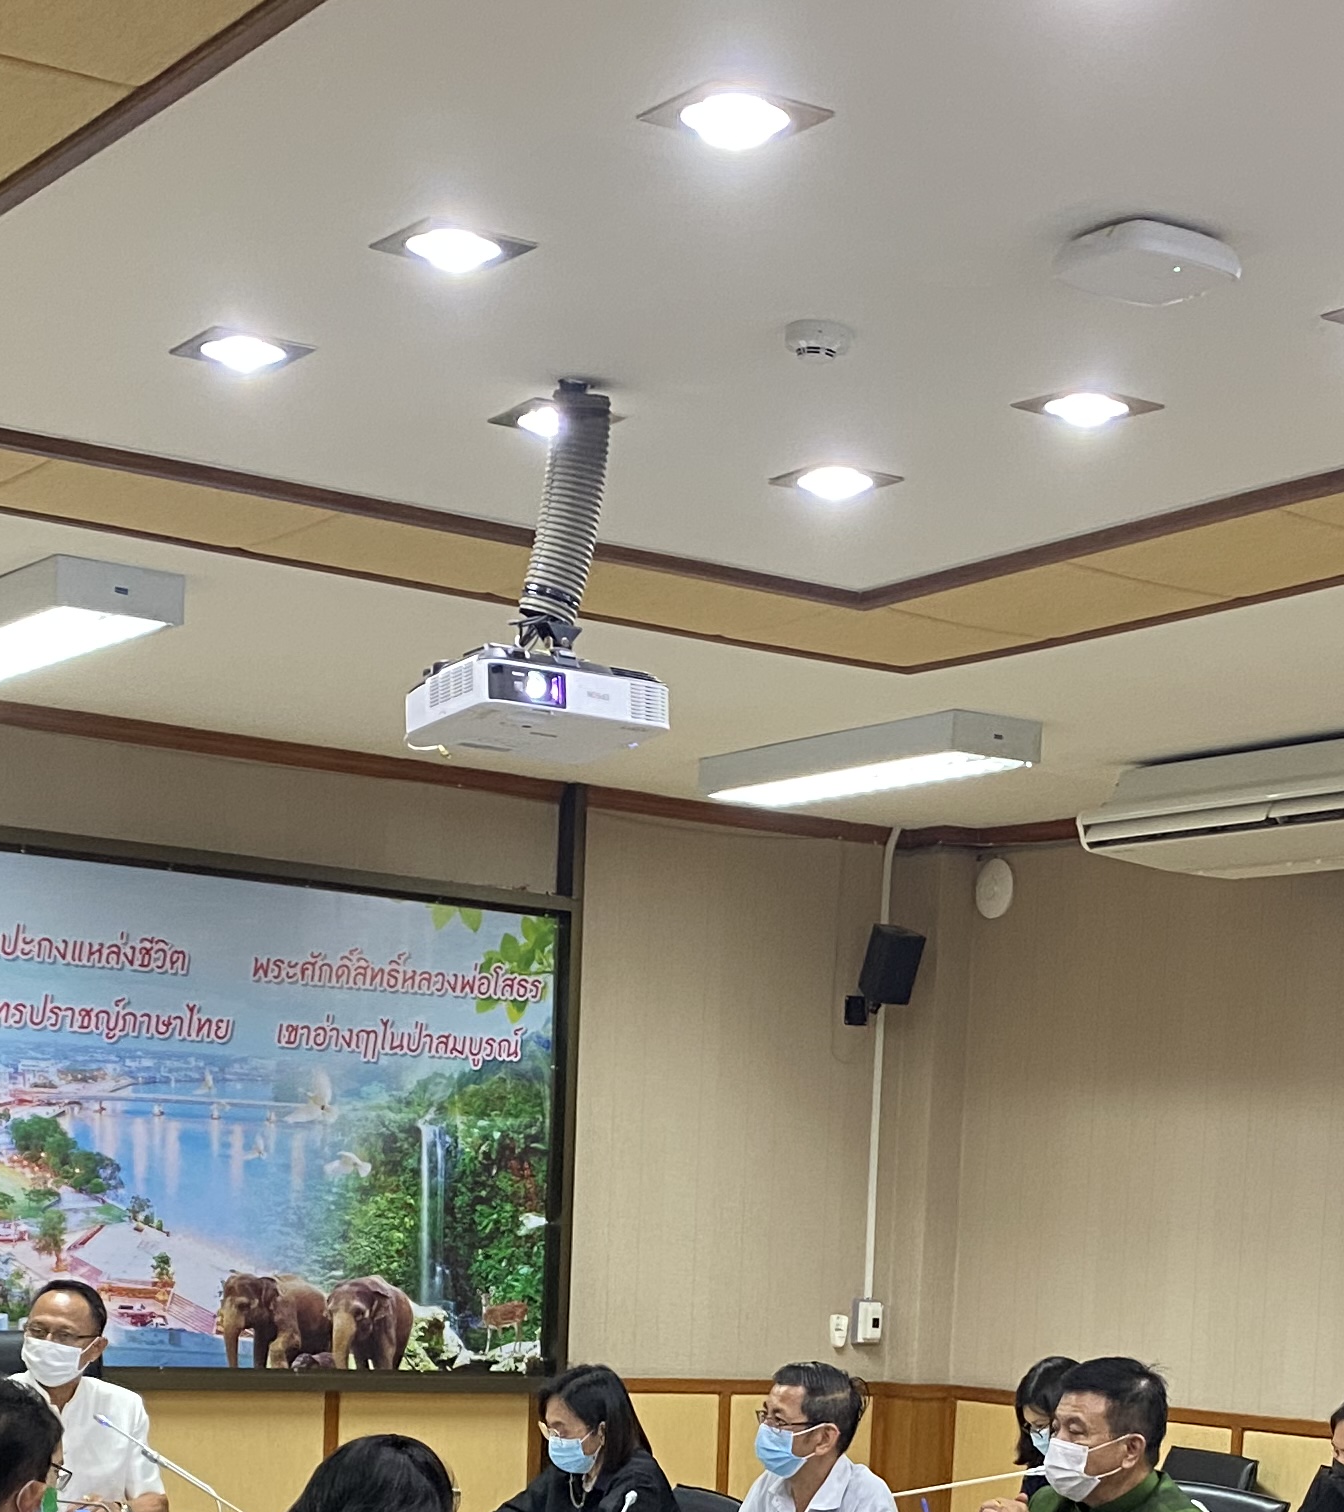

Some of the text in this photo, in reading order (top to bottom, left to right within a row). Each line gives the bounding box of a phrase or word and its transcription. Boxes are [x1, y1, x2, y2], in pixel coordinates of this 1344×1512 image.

[252, 948, 544, 1000] พระศักดิ์สิทธิ์หลวงพ่อโสธร
